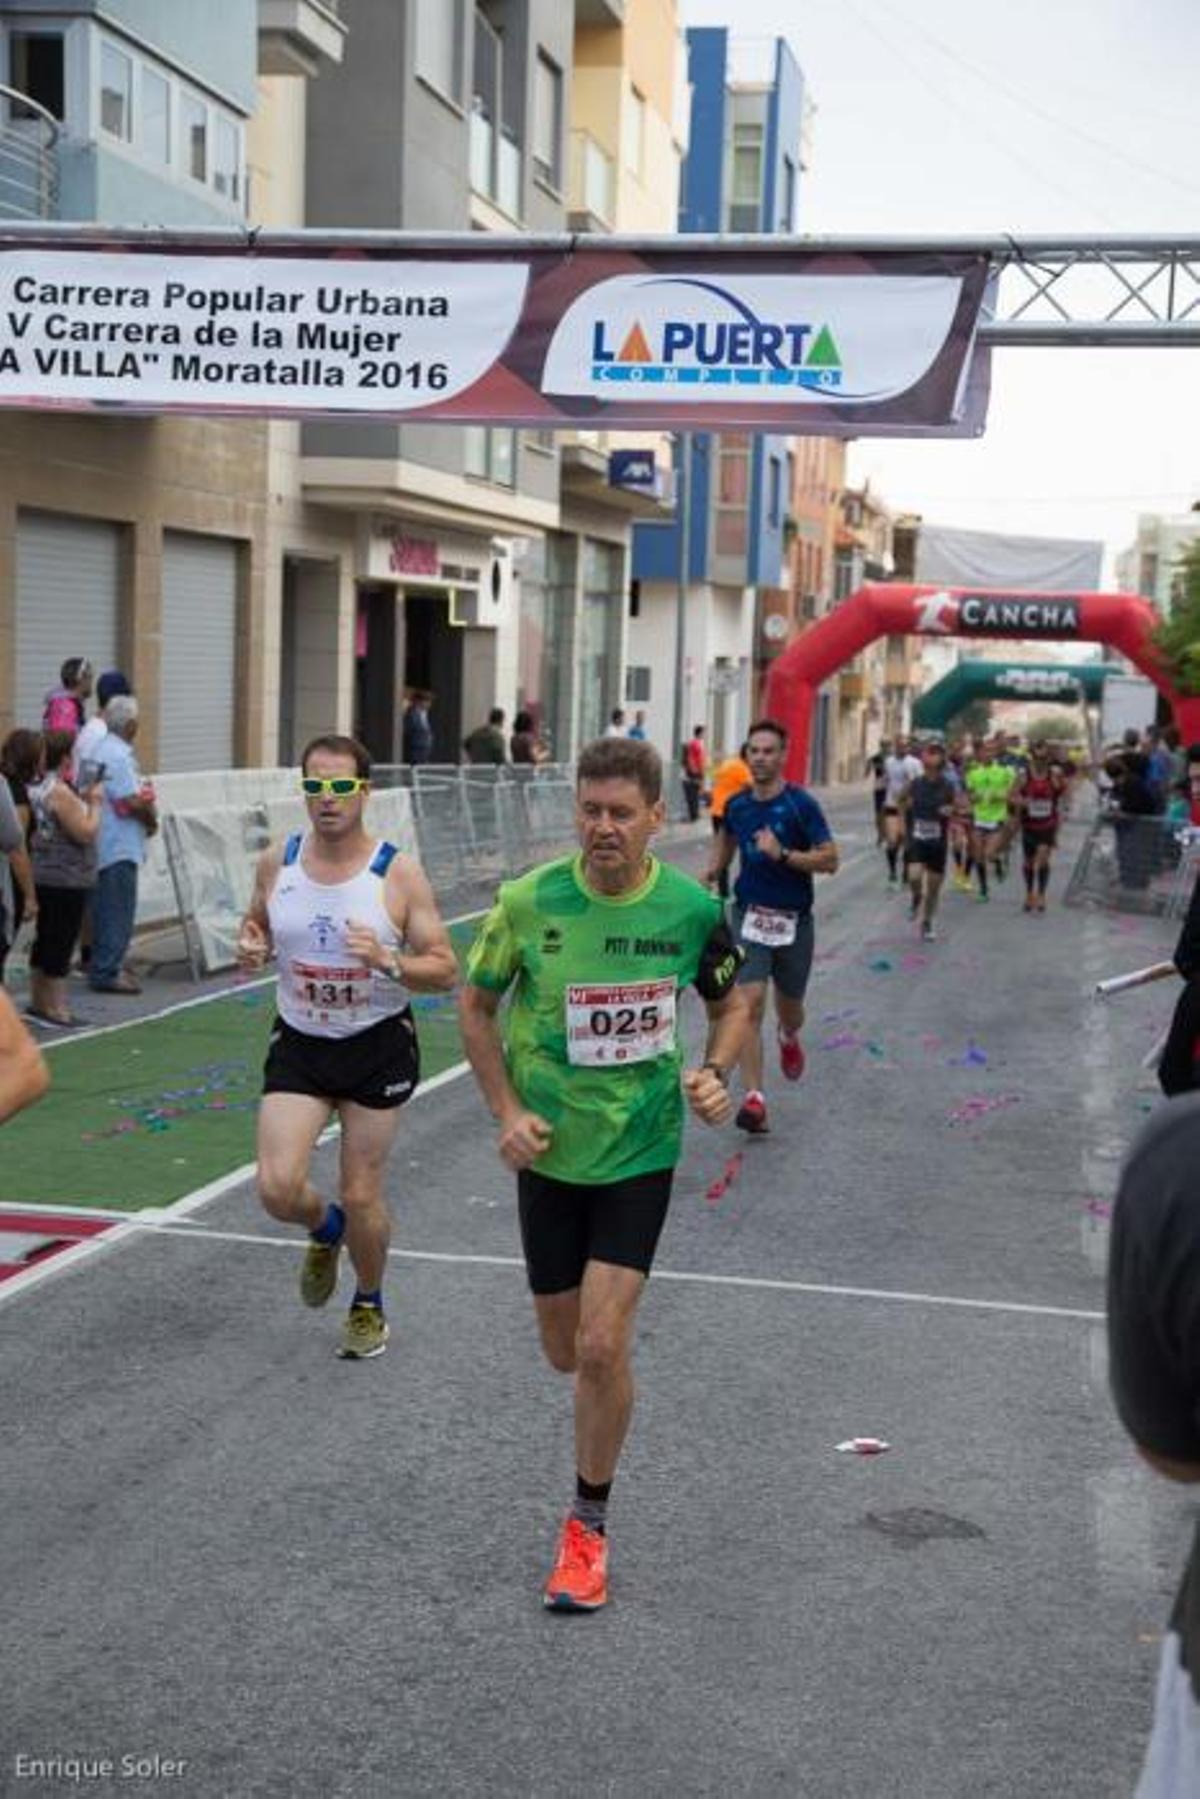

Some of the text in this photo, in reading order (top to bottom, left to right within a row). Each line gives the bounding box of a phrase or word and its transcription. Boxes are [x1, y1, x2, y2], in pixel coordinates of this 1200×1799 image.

[13, 276, 449, 317] Carrera Popular Urbana
[44, 313, 181, 345] Carrera
[194, 319, 239, 347] de
[252, 321, 284, 350] la
[297, 322, 402, 359] Mujer
[592, 321, 842, 368] LA PUERTA
[34, 348, 159, 379] VILLA"
[171, 353, 345, 387] Moratalla
[358, 361, 449, 391] 2016
[598, 367, 834, 385] COMPLEJO
[961, 598, 1078, 628] CANCHA
[305, 983, 353, 1005] 131
[590, 1006, 659, 1036] 025
